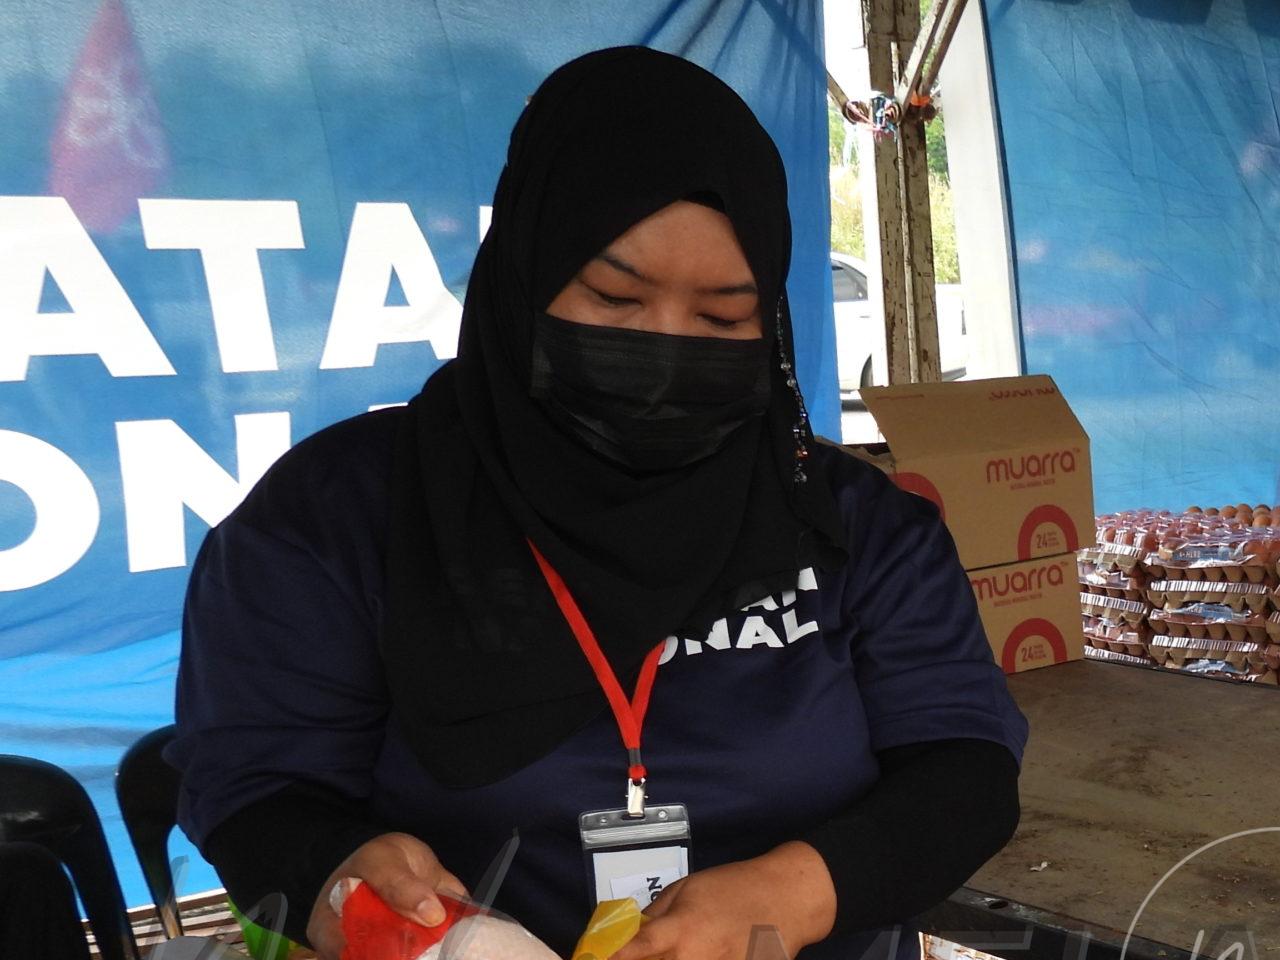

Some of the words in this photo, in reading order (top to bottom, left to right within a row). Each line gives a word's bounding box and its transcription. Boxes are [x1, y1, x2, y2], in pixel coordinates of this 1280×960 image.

[0, 195, 493, 382] ATA
[986, 450, 1075, 484] muarra
[1036, 532, 1048, 549] 24
[658, 608, 819, 665] NAL
[1021, 645, 1034, 662] 24
